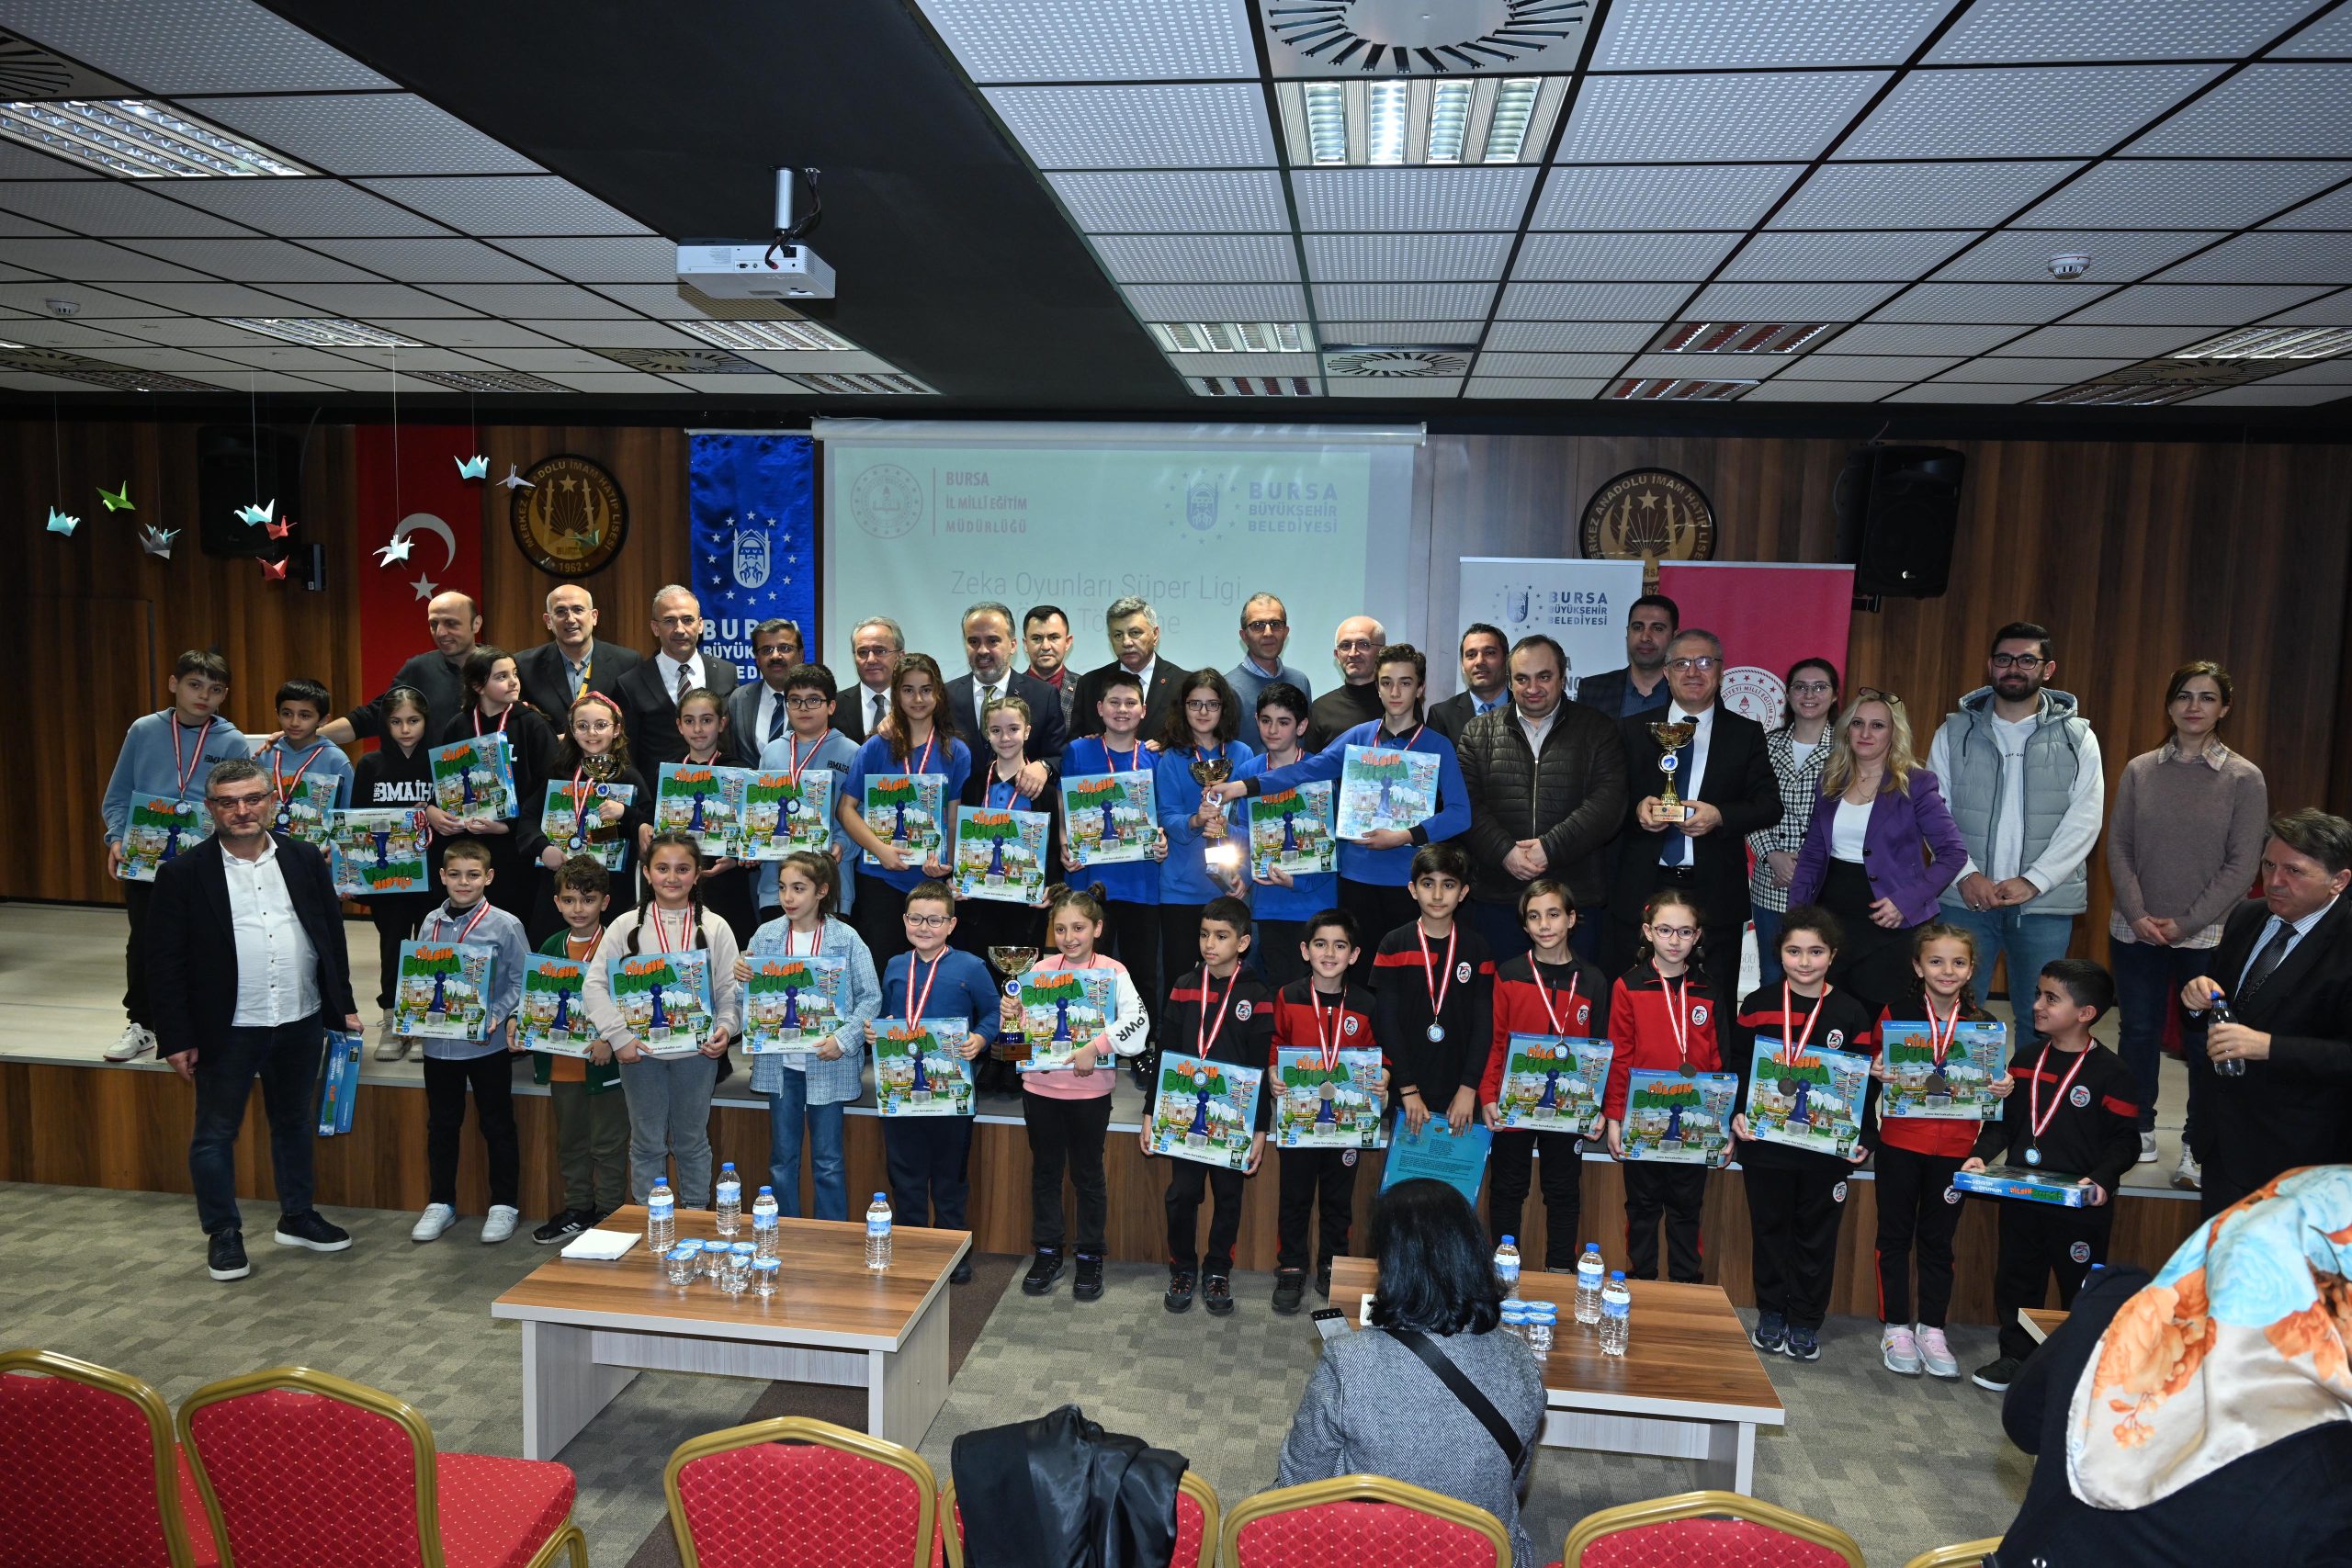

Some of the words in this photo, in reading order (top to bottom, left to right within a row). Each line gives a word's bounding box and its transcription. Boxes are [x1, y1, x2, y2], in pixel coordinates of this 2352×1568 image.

[524, 461, 566, 497] AADOLU
[946, 471, 989, 486] BURSA
[1250, 482, 1338, 501] BURSA
[946, 494, 956, 510] İL
[958, 495, 988, 510] MİLLİ
[990, 494, 1027, 510] EĞİTİM
[1250, 502, 1338, 517] BÜYÜKŞEHİR
[519, 500, 535, 548] MERKEZ
[1589, 517, 1600, 558] ERKEZ
[1595, 476, 1647, 515] ANADOLU
[1652, 476, 1685, 493] İMAM
[1694, 532, 1709, 559] LİSE
[946, 518, 1026, 533] MÜDÜRLÜĞÜ
[1249, 518, 1337, 533] BELEDİYESİ
[559, 562, 582, 572] 1962
[952, 570, 1007, 595] Zeka
[1015, 572, 1112, 604] Oyunları
[1121, 573, 1191, 605] Süper
[1200, 575, 1241, 607] Ligi
[1549, 592, 1608, 604] BURSA
[1548, 615, 1608, 625] BELEDİYESİ
[703, 642, 756, 660] BÜYÜK
[1744, 685, 1762, 694] MİLLİ
[379, 780, 433, 802] BMAİH
